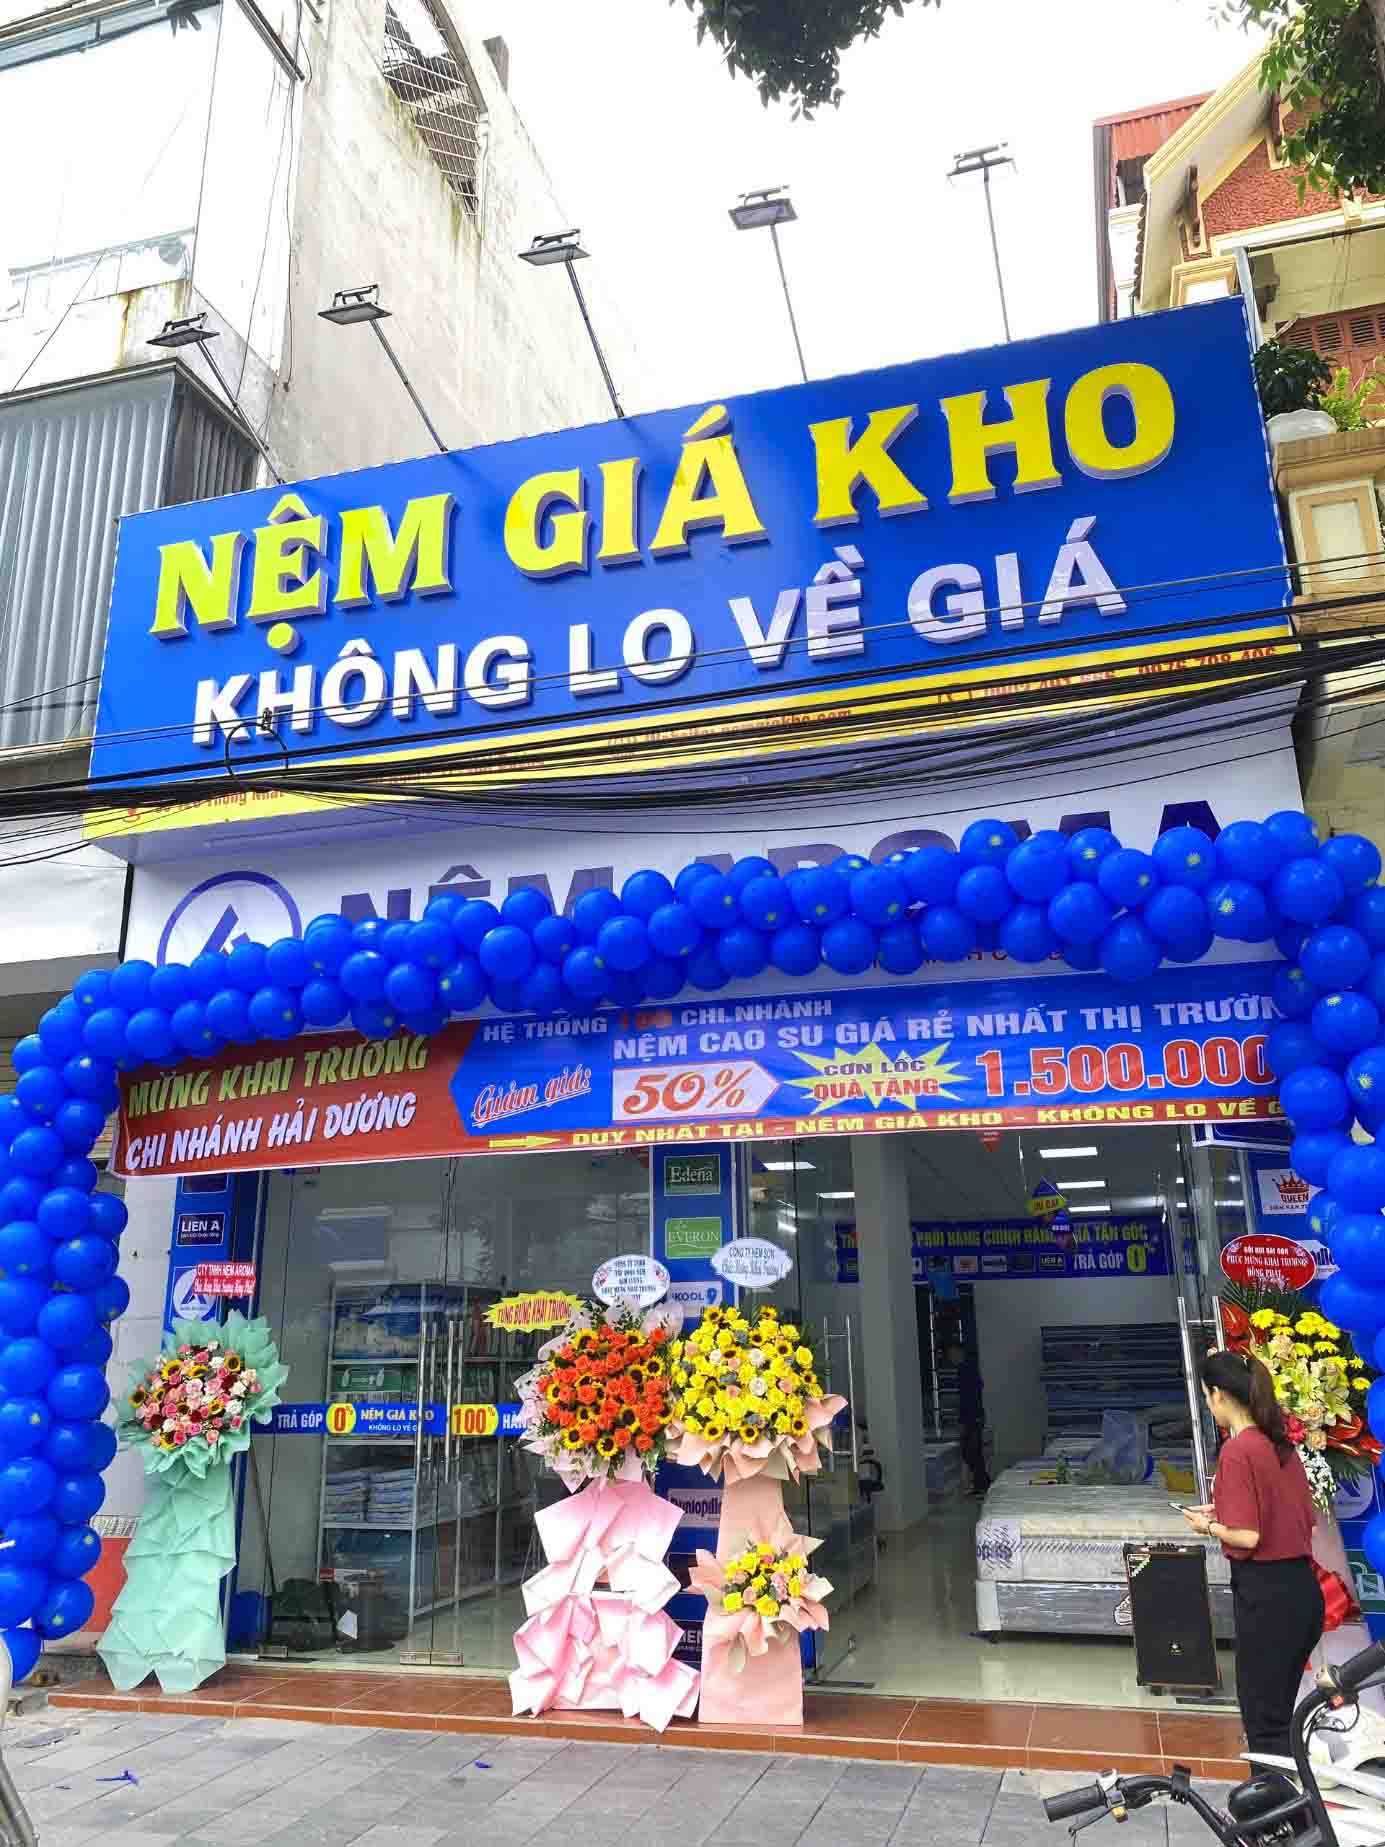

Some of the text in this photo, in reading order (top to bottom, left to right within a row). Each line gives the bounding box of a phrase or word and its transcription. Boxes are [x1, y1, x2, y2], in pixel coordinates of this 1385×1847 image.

[150, 363, 1176, 656] NỆM GIÁ KHO
[192, 516, 1127, 746] KHÔNG LO VỀ GIÁ
[483, 1021, 514, 1043] HỆ
[613, 993, 1286, 1062] NỆM CAO SU GIÁ RẺ NHẤT THỊ TRƯỜN
[823, 1060, 873, 1076] CƠN
[128, 1069, 210, 1118] MỪNG
[218, 1056, 295, 1102] KHAI
[622, 1066, 754, 1115] 50%
[813, 1078, 865, 1101] QUÀ
[125, 1091, 418, 1170] CHI NHÁNH HẢI DƯƠNG
[571, 1128, 627, 1146] DUY
[937, 1112, 1003, 1128] KHO
[1036, 1102, 1154, 1124] KHÔNG
[1166, 1102, 1208, 1119] LO
[1217, 1097, 1257, 1116] VỀ
[1281, 1193, 1309, 1203] QUEEN
[182, 1220, 208, 1232] LIEN
[668, 1230, 720, 1243] EVERON
[1073, 1250, 1097, 1270] TRẢ
[1099, 1248, 1124, 1269] GÓP
[278, 1408, 324, 1430] TRẢ GÓP
[386, 1407, 406, 1421] GIÁ
[410, 1409, 435, 1421] KO
[453, 1407, 497, 1435] 100%
[392, 1424, 401, 1432] LO
